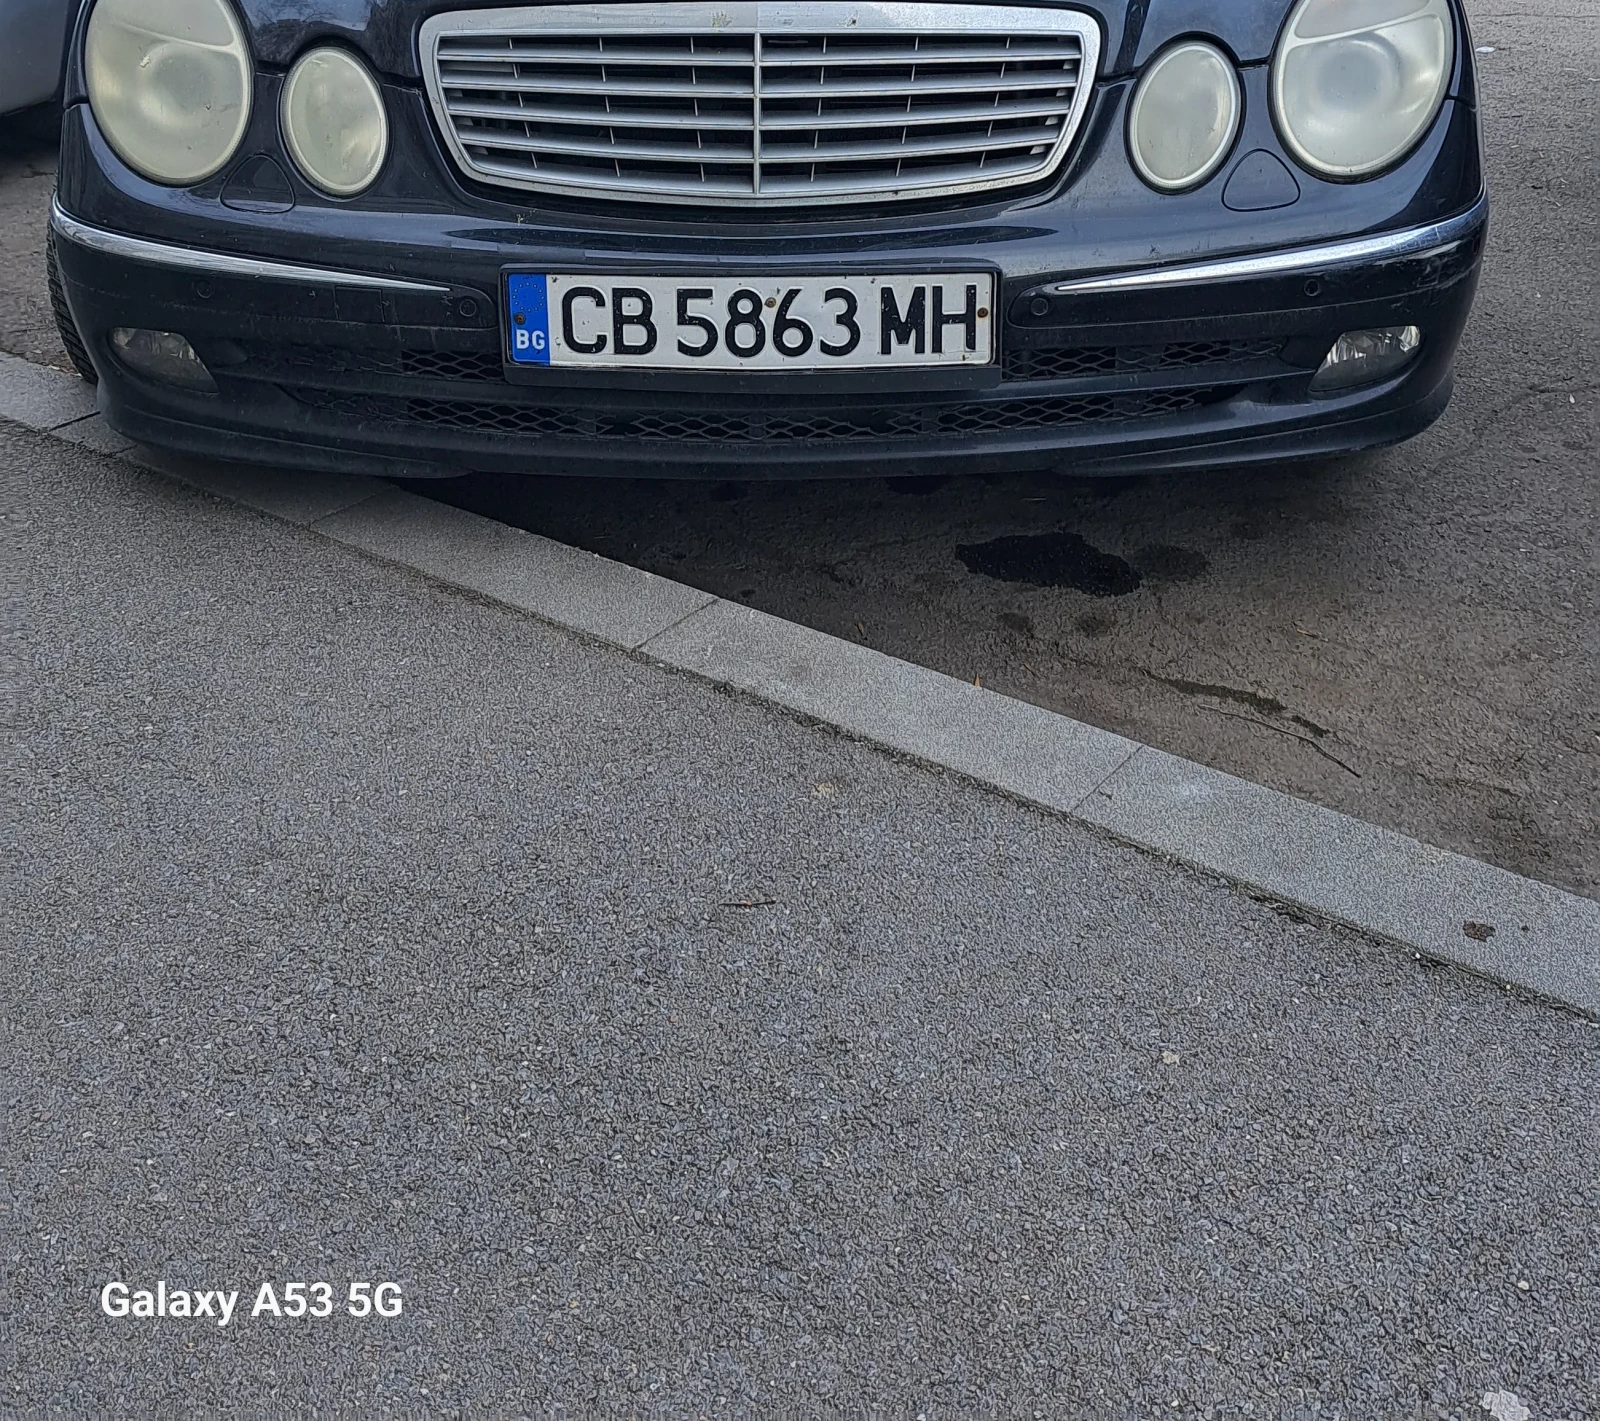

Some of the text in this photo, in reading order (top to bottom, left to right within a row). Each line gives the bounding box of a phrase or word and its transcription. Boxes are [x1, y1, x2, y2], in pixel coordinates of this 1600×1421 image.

[516, 329, 545, 350] BG
[562, 285, 976, 357] CB 5863 MH
